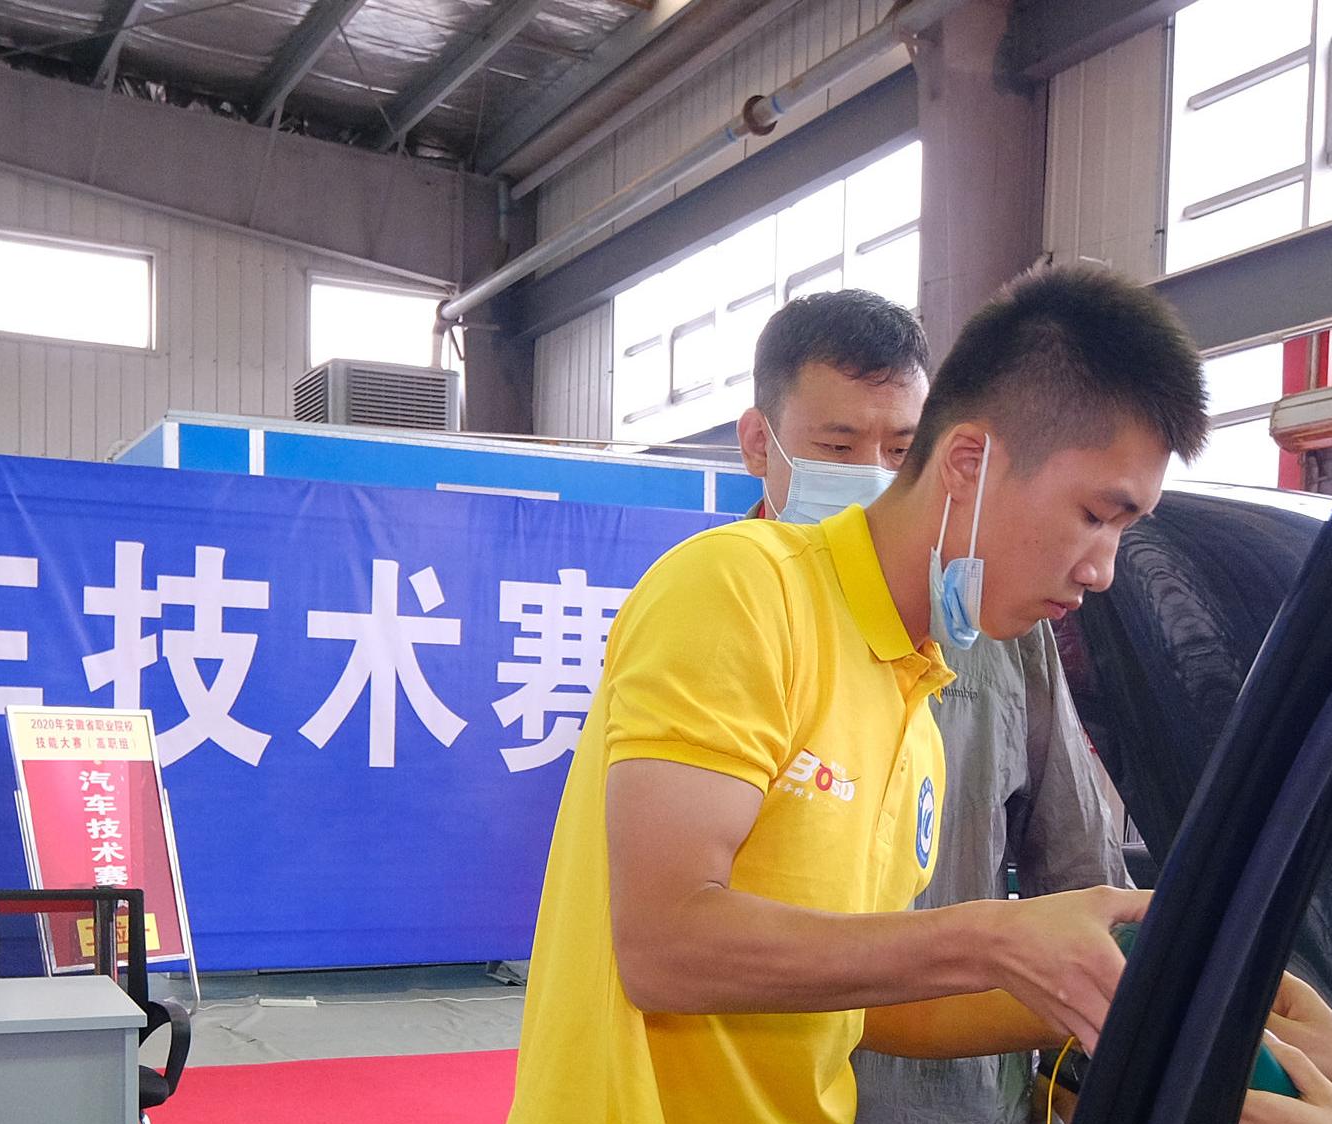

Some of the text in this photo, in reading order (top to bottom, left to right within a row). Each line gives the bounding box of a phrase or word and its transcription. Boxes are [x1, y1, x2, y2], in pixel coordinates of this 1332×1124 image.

[78, 770, 129, 887] 汽车技术赛
